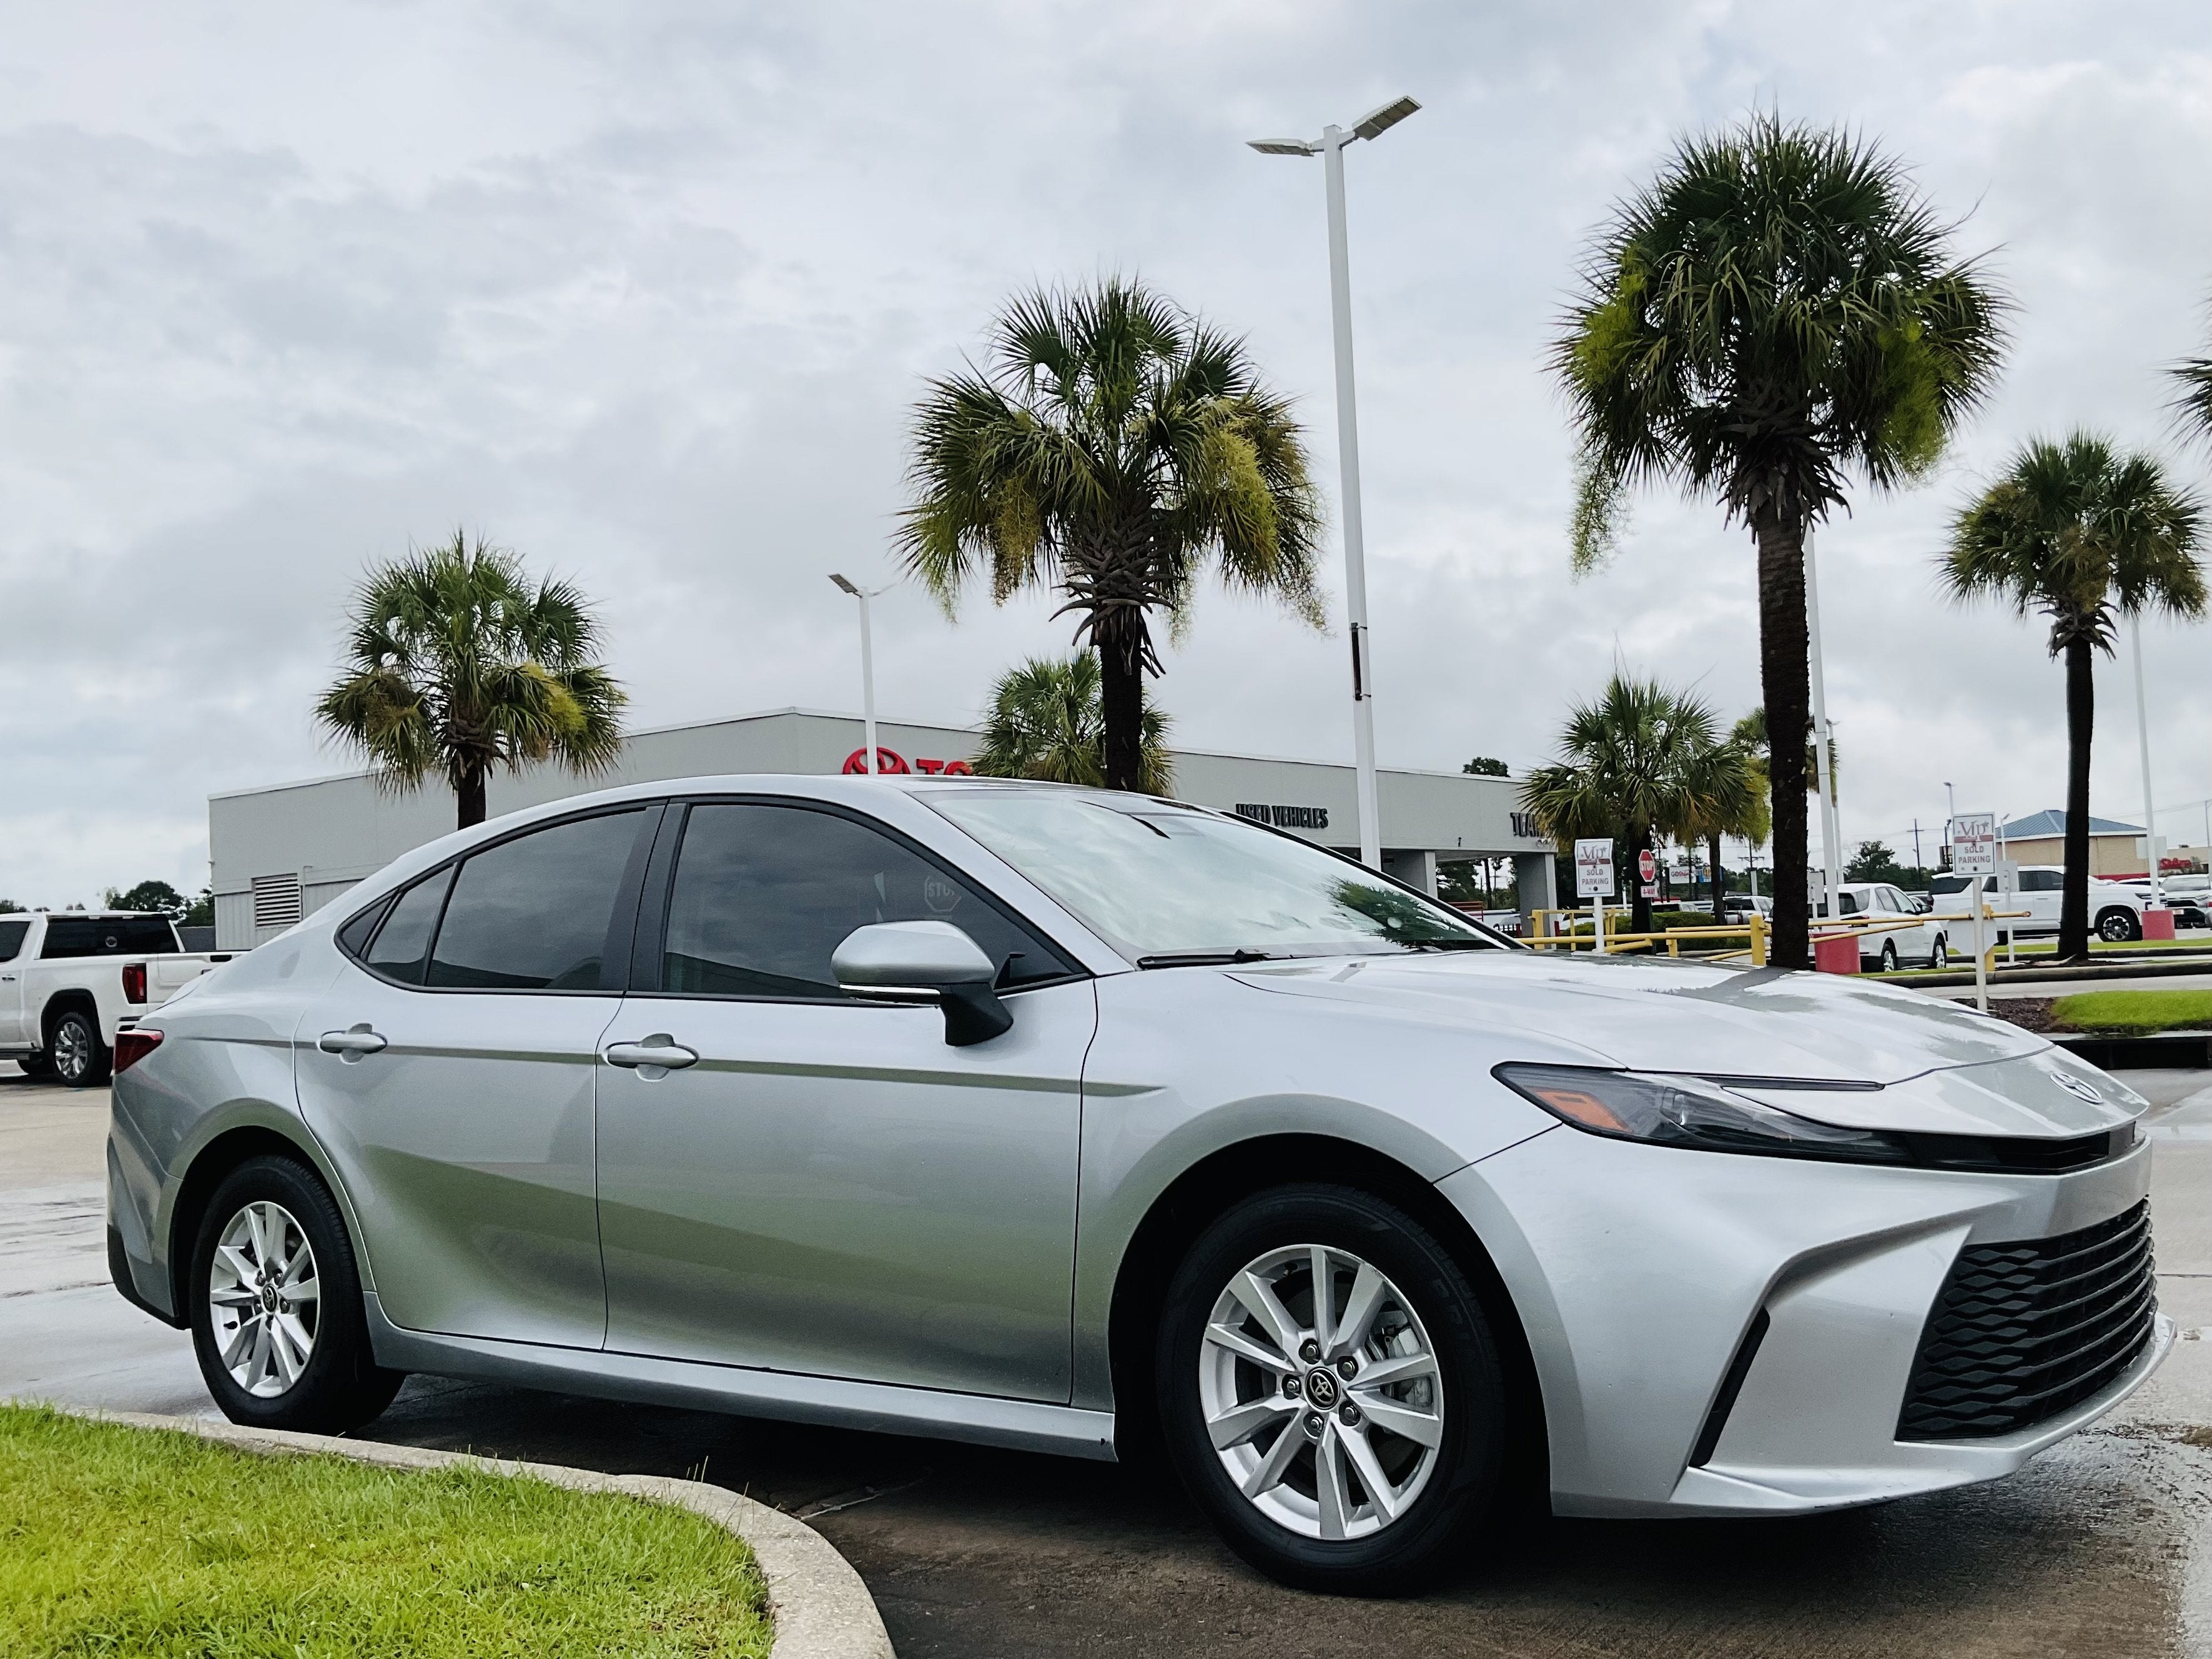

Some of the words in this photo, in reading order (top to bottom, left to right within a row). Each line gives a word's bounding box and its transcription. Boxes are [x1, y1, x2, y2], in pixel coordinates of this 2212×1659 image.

[1236, 803, 1271, 825] USED
[1271, 805, 1329, 828] VEHICLES
[1964, 846, 1984, 854] SOLD
[1958, 855, 1991, 864] PARKING
[1640, 859, 1654, 871] STOP
